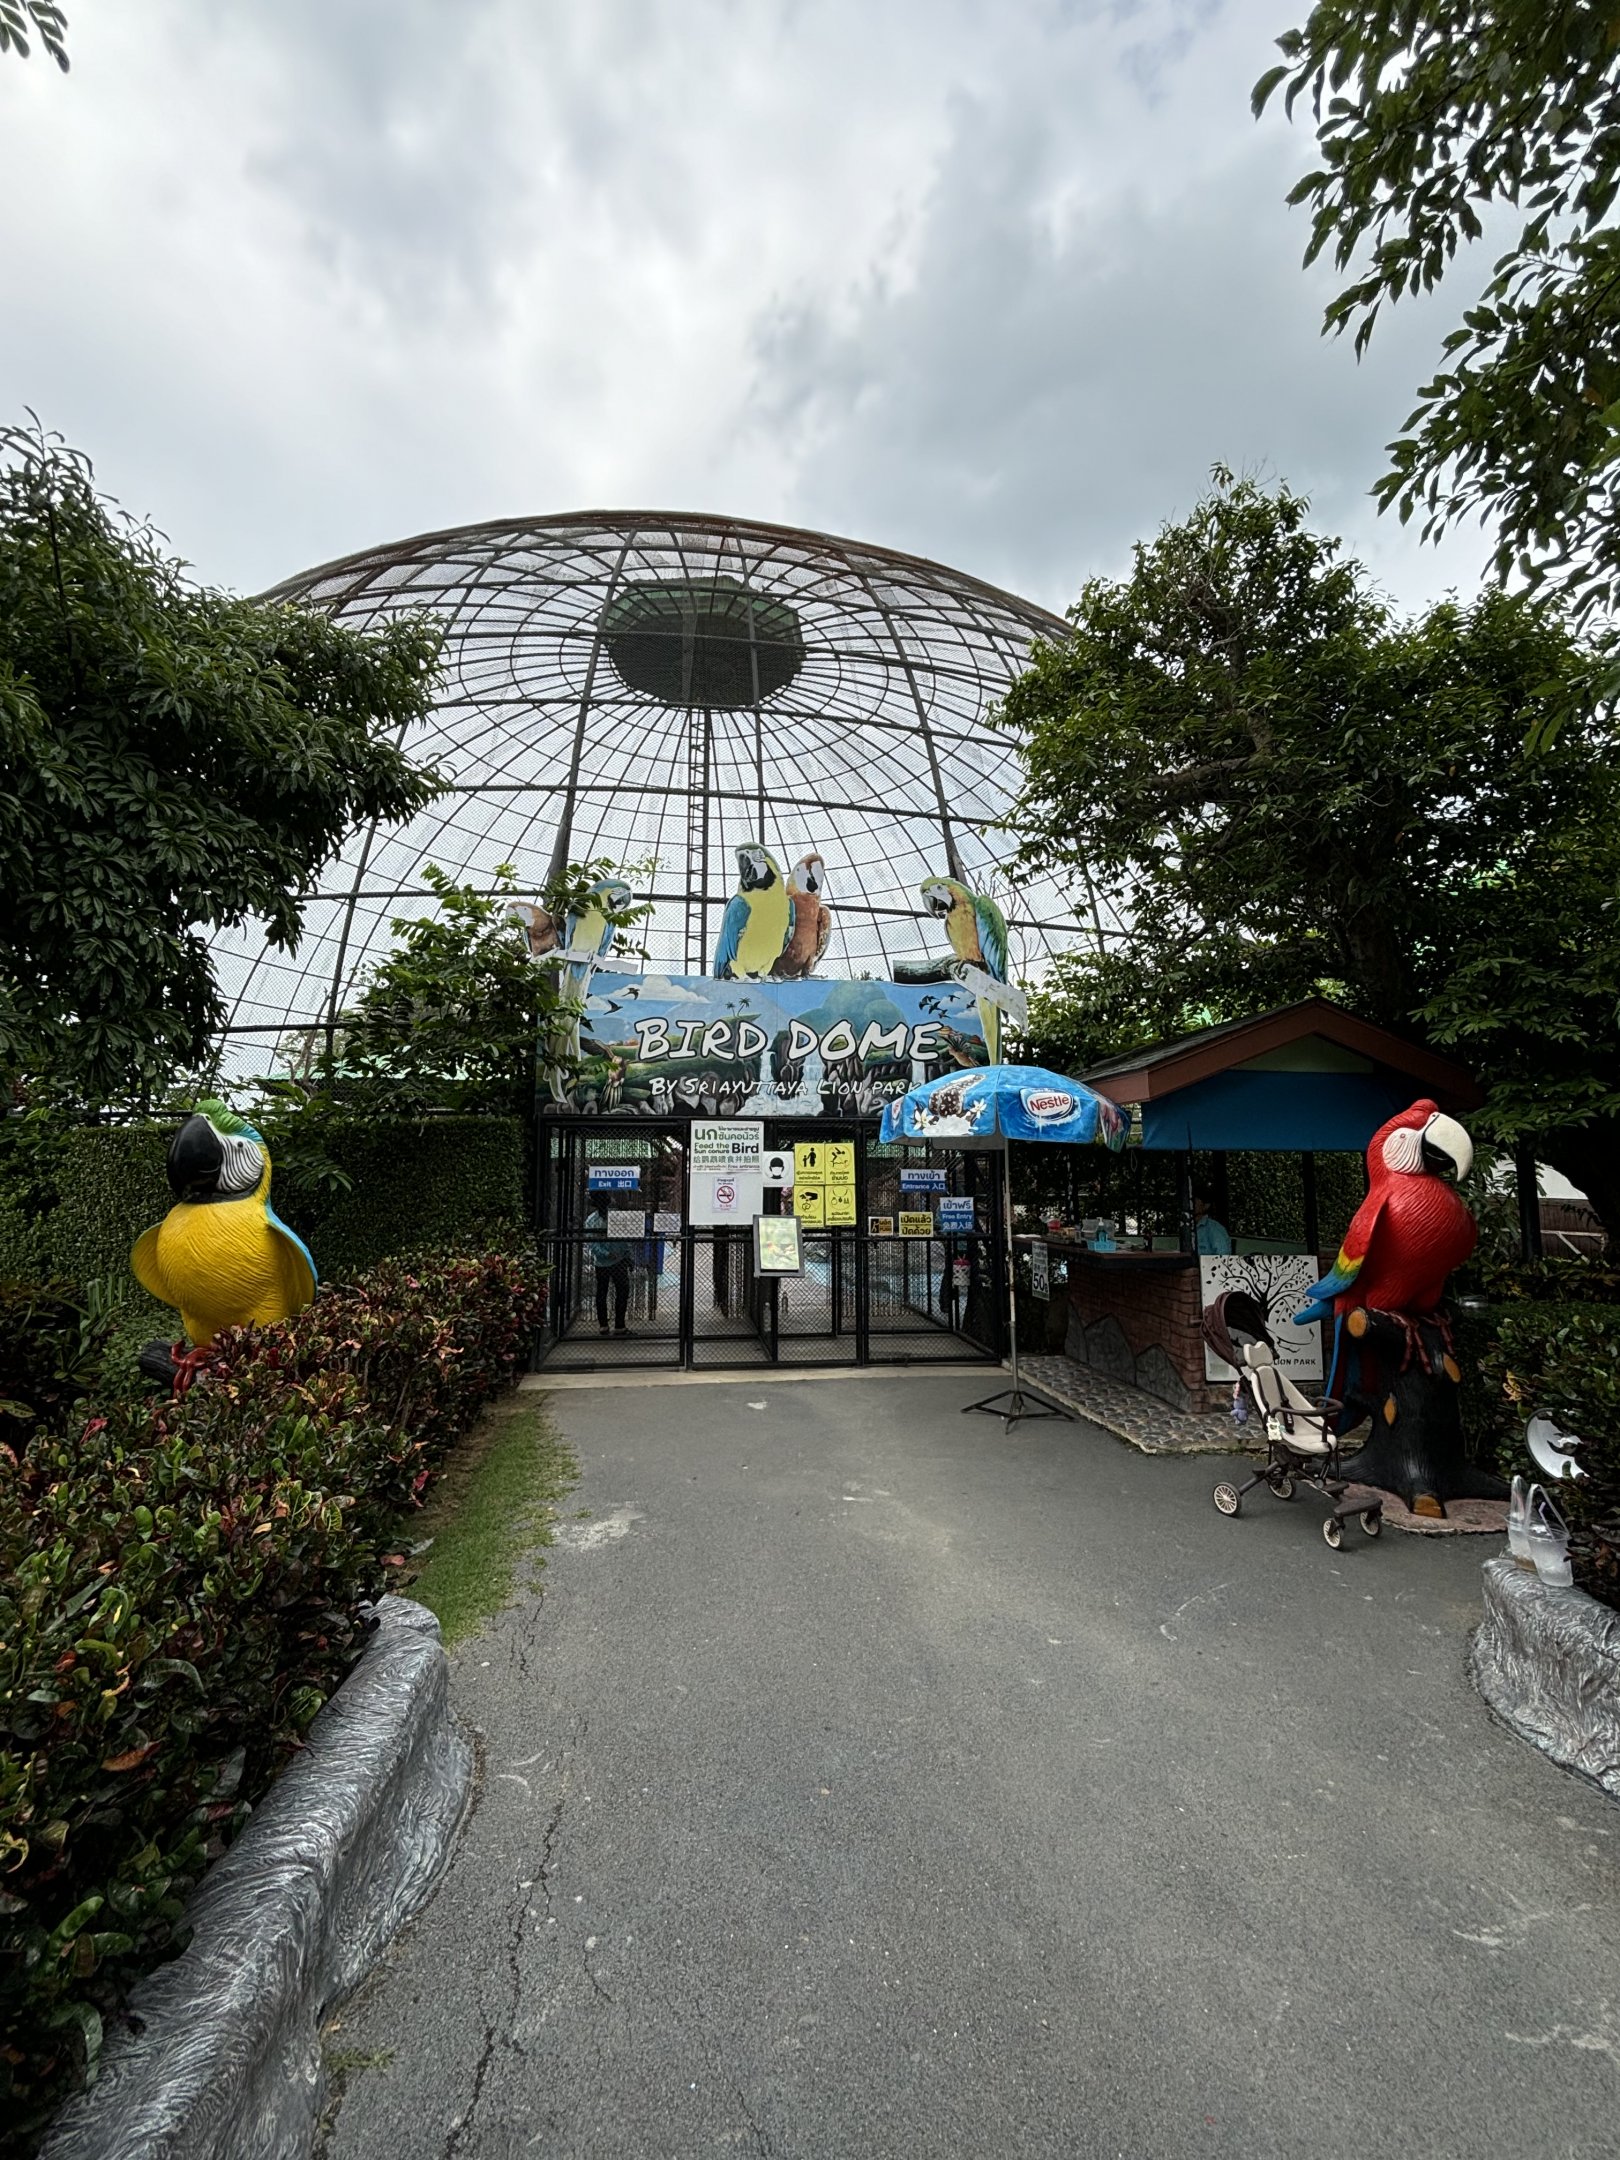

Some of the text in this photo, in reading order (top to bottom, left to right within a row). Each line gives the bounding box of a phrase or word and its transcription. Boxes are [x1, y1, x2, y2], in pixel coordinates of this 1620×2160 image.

[634, 1017, 944, 1062] BIRD DOME
[694, 1128, 718, 1140] นก
[731, 1142, 759, 1154] Bird
[907, 1170, 941, 1180] ทางเข้า
[617, 1180, 632, 1188] 出口
[943, 1200, 972, 1209] เข้าฟรี
